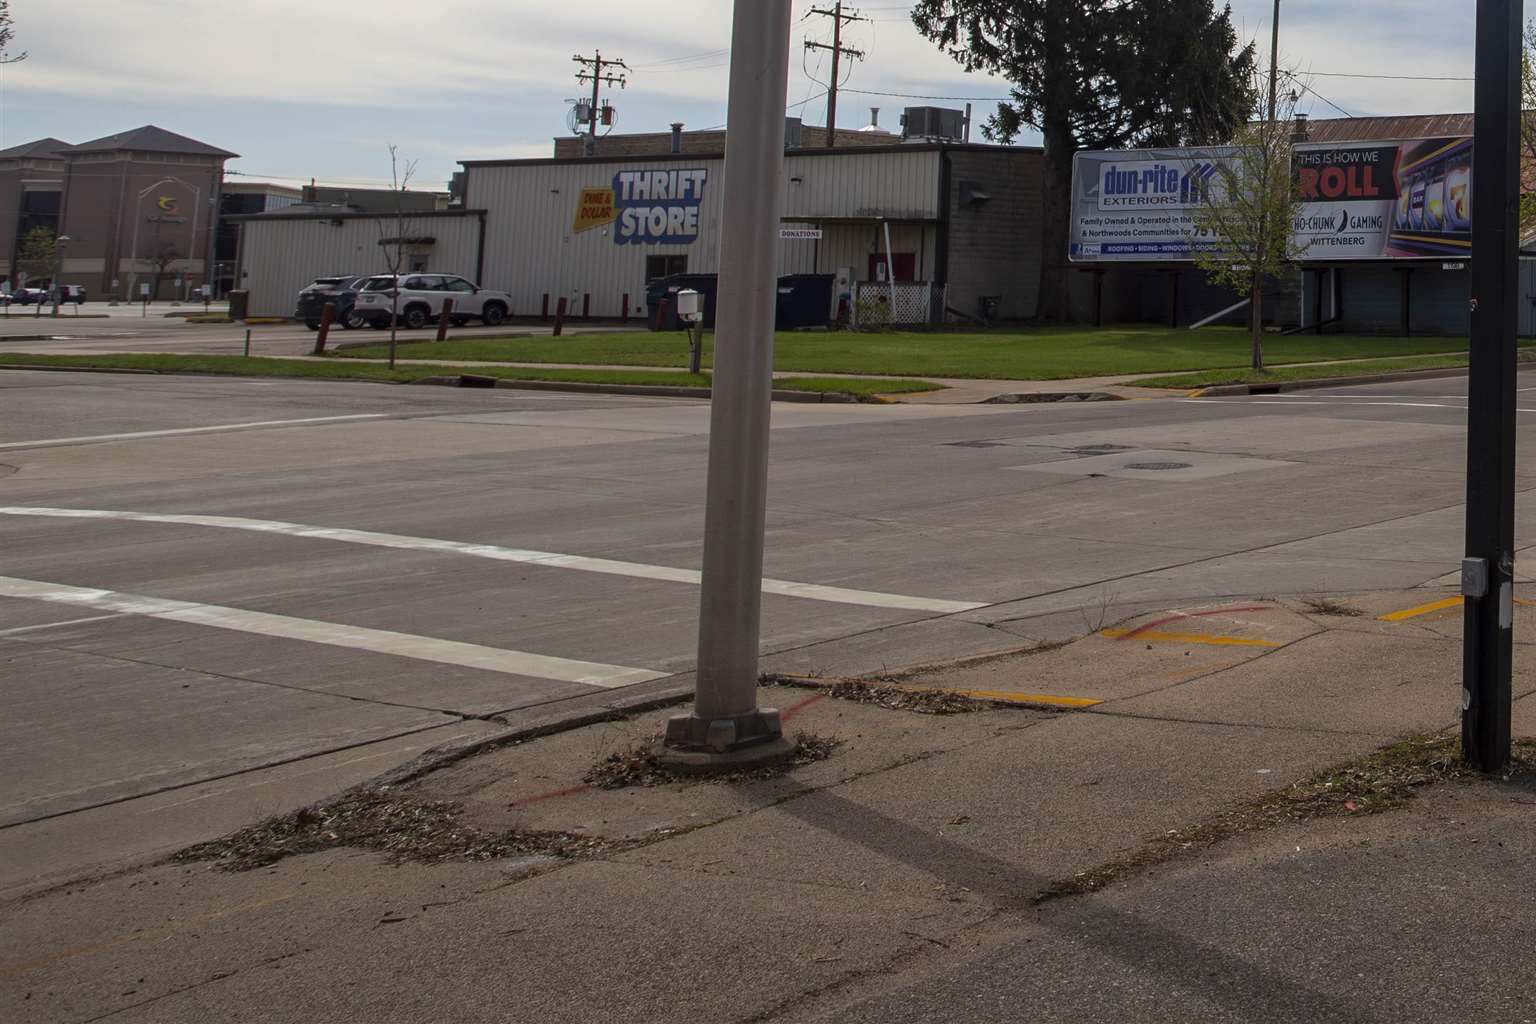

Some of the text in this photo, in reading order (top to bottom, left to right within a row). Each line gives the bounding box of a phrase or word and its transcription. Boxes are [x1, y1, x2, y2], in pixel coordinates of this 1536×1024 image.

[1297, 151, 1379, 164] THIS IS HOW WE
[620, 169, 707, 201] THRIFT
[1104, 164, 1179, 194] dun-rite
[1297, 165, 1379, 199] ROLL
[1103, 196, 1177, 206] EXTERIORS
[581, 207, 612, 219] DOLLAR
[621, 206, 699, 237] STORE
[1080, 217, 1103, 226] Family
[1104, 216, 1129, 225] Owned
[1130, 216, 1136, 224] &
[1137, 215, 1171, 225] Operated
[1172, 215, 1179, 224] in
[1180, 215, 1192, 223] the
[1294, 215, 1382, 230] HO-CHUNK GAMING
[1088, 229, 1132, 237] Northwoods
[1133, 228, 1180, 236] Communities
[1180, 227, 1191, 236] for
[1310, 236, 1365, 246] WITTENBERG
[1107, 244, 1135, 252] ROOFING
[1138, 244, 1159, 252] SIDING
